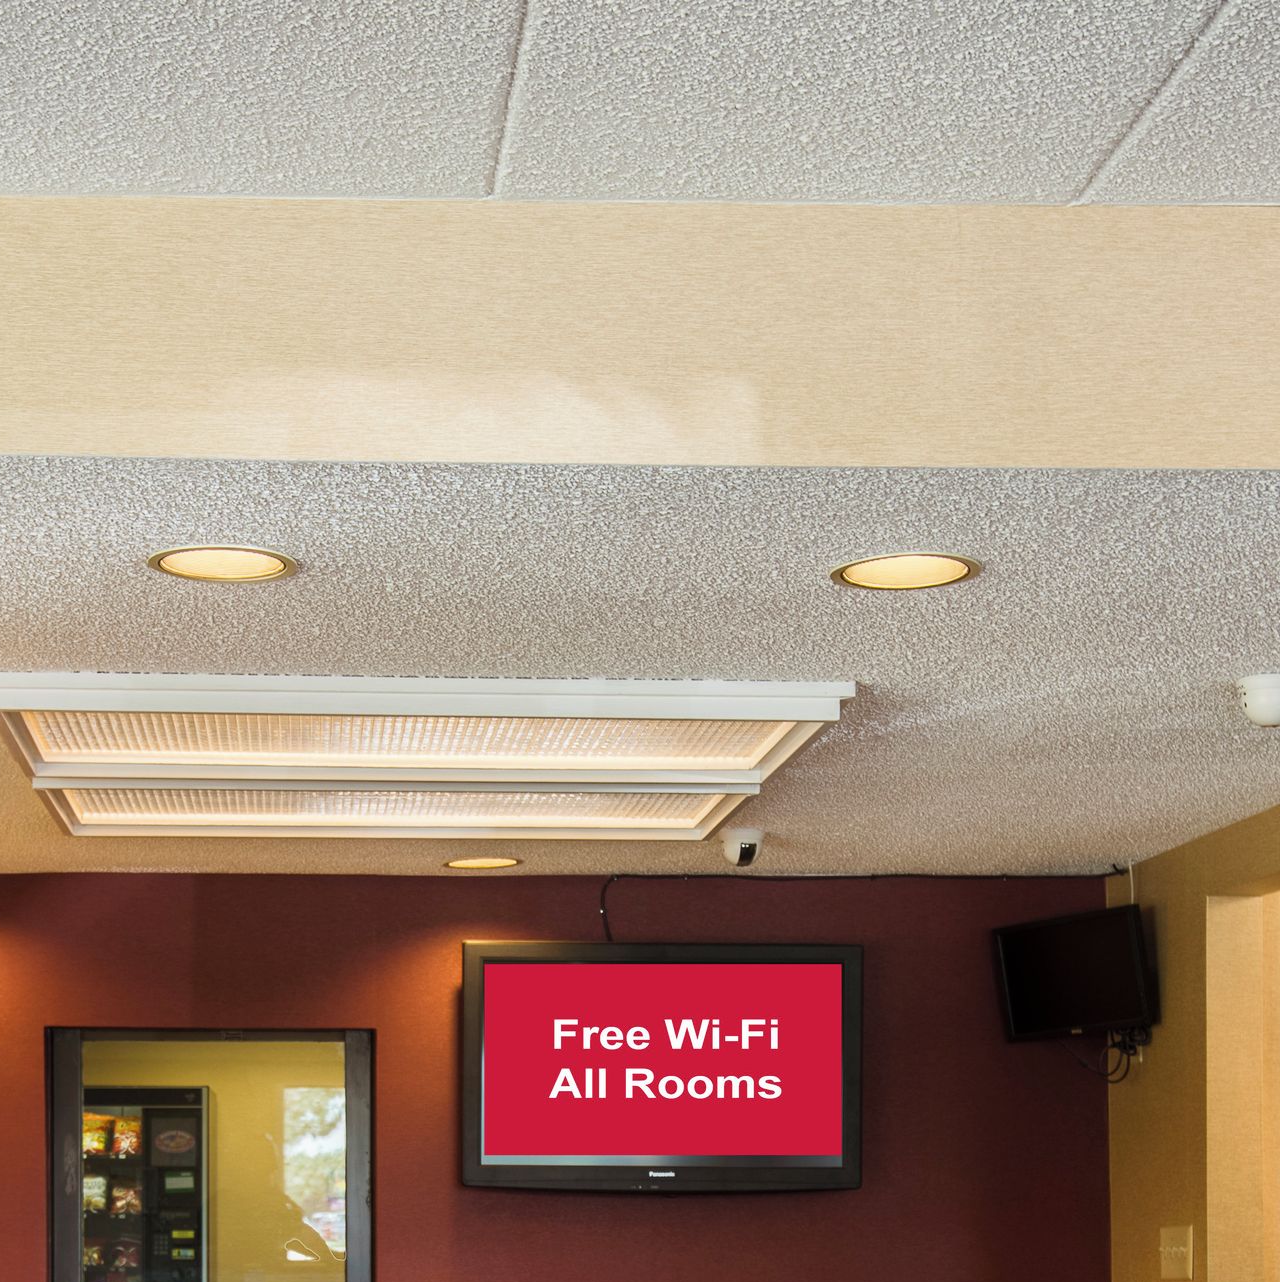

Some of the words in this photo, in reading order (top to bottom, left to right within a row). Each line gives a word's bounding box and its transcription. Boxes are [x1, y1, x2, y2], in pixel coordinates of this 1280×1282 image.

[553, 1018, 651, 1051] Free
[664, 1018, 779, 1050] Wi-Fi
[548, 1067, 607, 1099] All
[625, 1067, 783, 1100] Rooms
